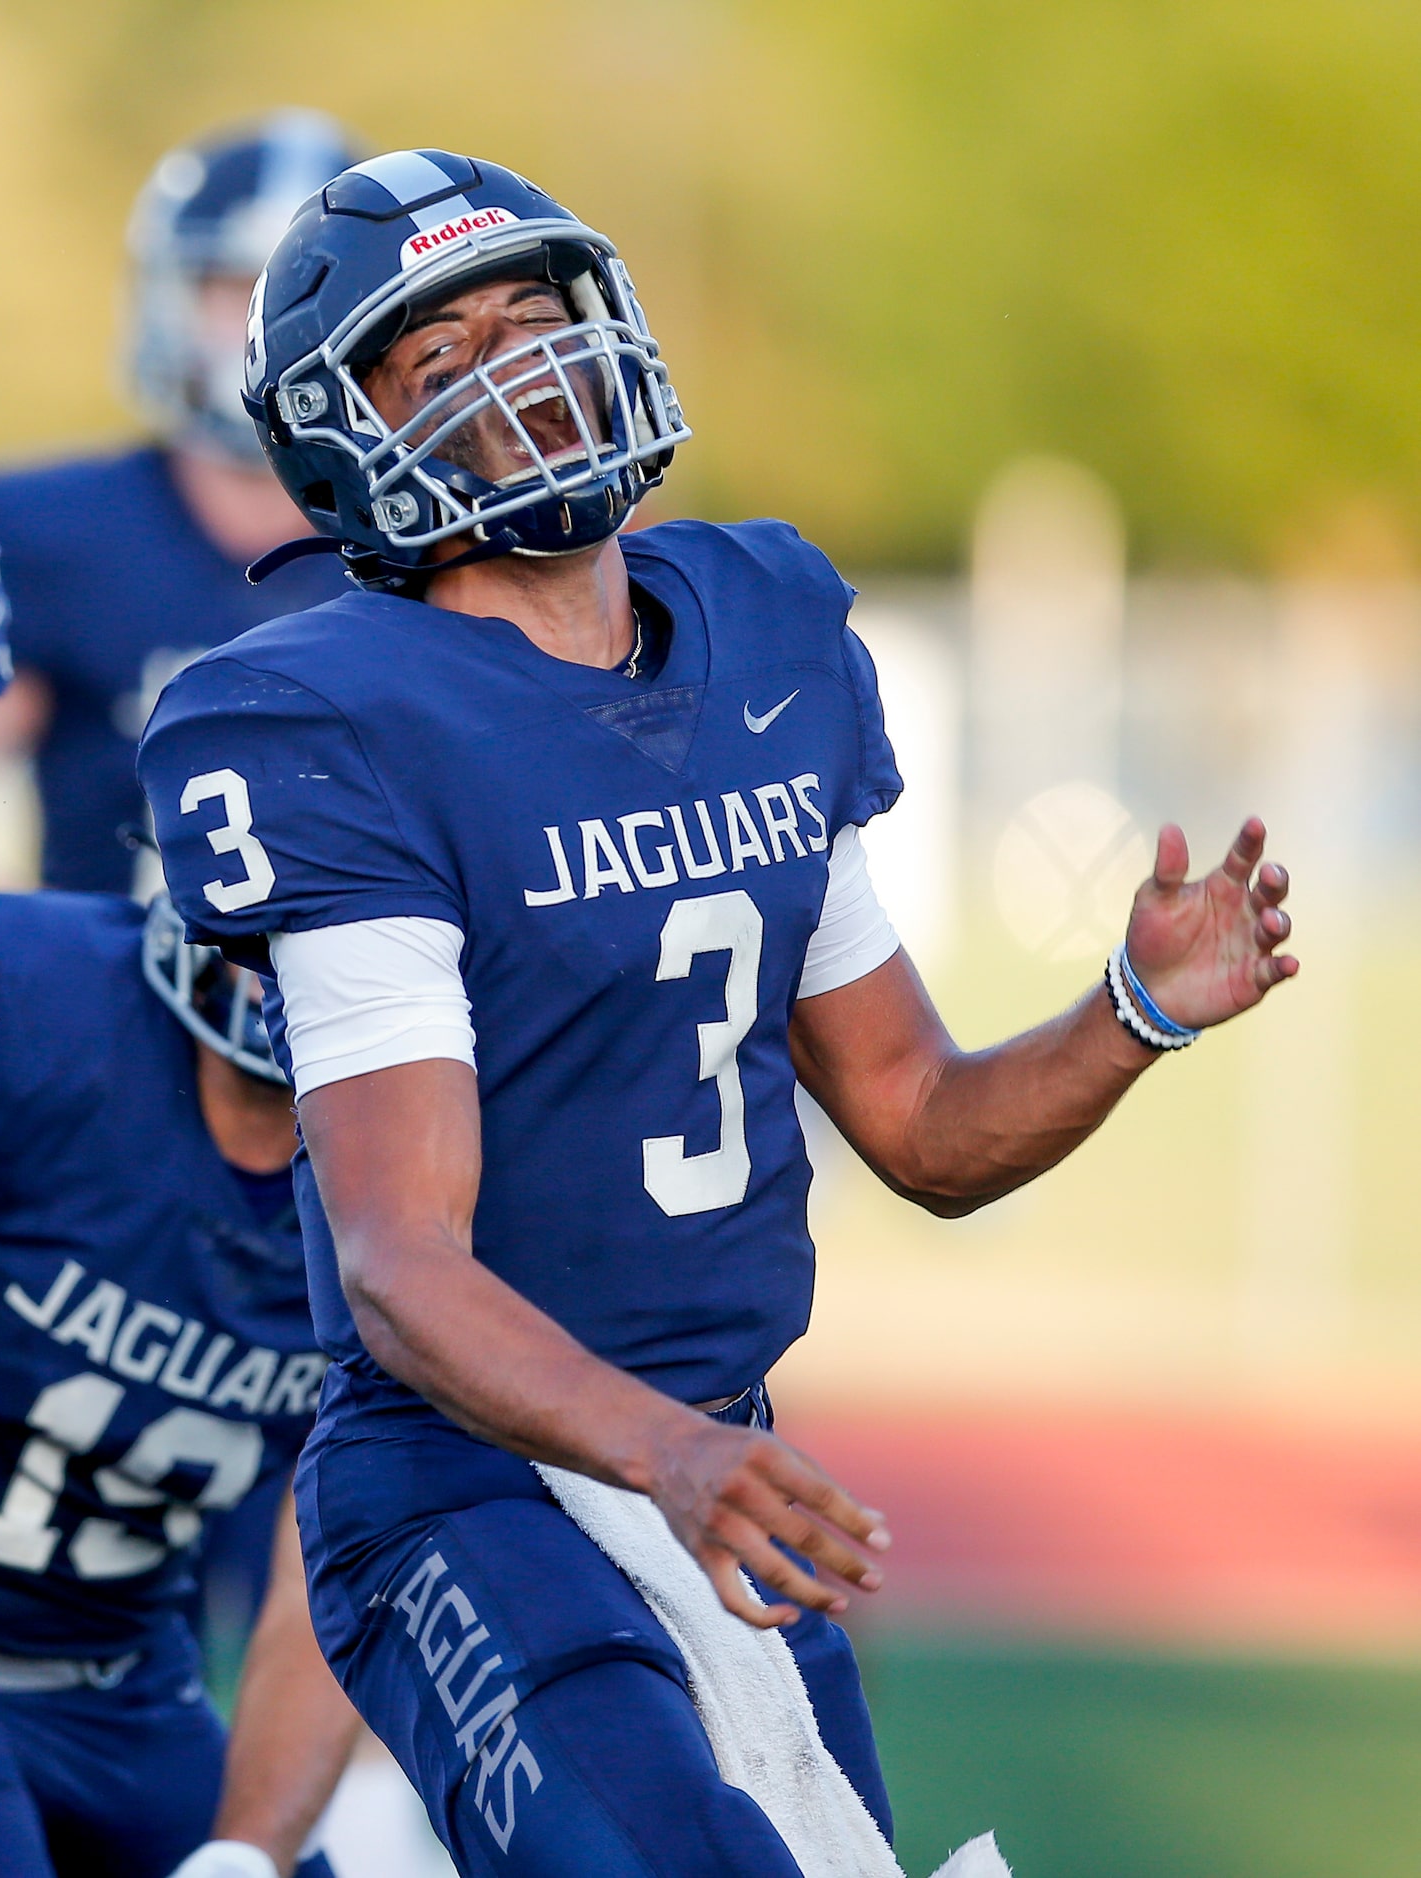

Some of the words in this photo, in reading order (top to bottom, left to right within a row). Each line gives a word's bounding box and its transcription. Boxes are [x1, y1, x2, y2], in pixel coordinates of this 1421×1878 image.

[409, 209, 506, 255] Riddell
[180, 767, 275, 914] 3
[523, 772, 828, 907] JAGUARS
[642, 889, 763, 1217] 3
[4, 1259, 323, 1416] JAGUAR
[368, 1540, 544, 1856] AGUARS
